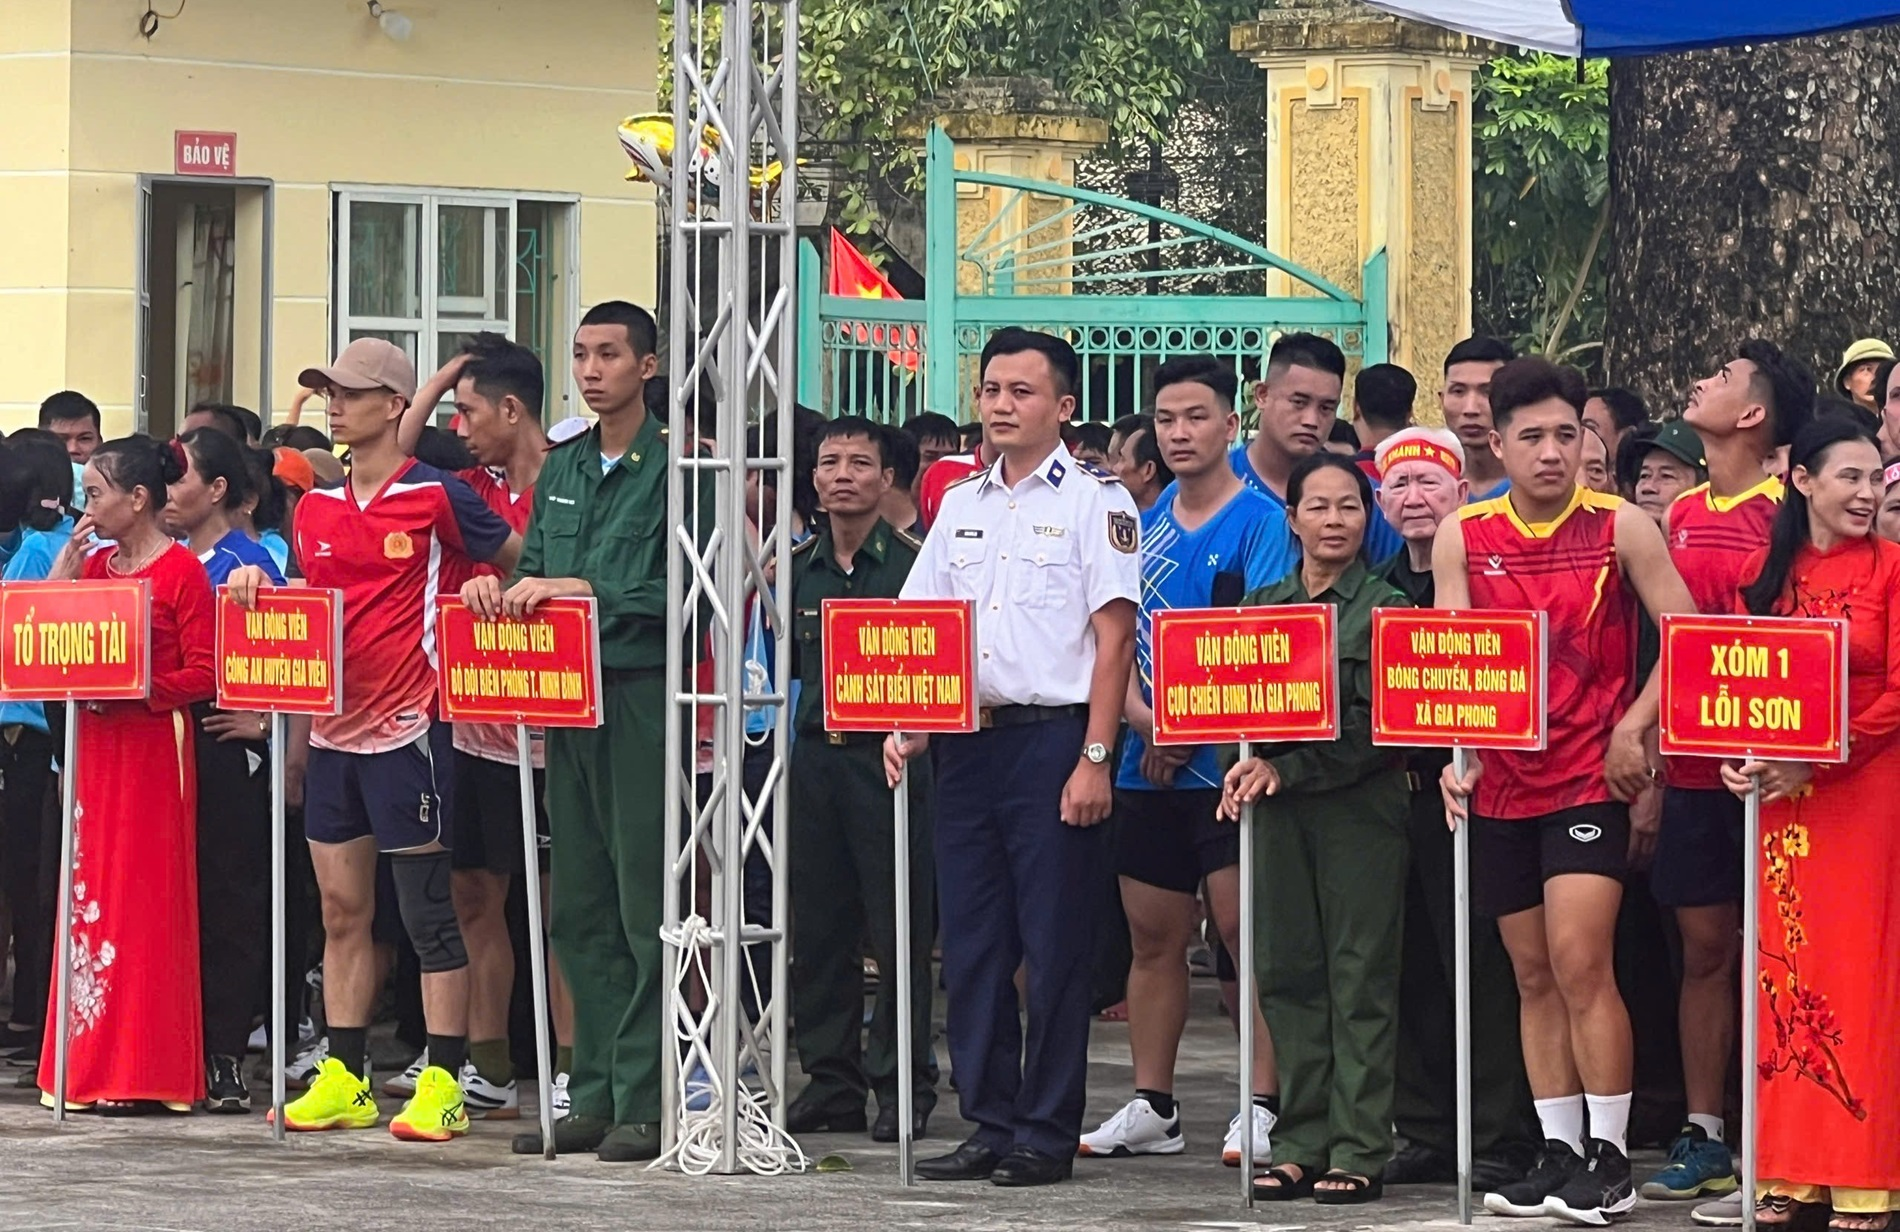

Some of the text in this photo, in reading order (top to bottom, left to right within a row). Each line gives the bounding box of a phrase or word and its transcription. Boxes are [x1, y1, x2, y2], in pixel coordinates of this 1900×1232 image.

[183, 137, 230, 170] BẢO VỆ
[13, 605, 127, 675] TỔ TRỌNG TÀI
[529, 618, 555, 653] VIÊN
[858, 620, 936, 662] VẬN ĐỘNG VIÊN
[1195, 628, 1290, 672] VẬN ĐỘNG VIÊN
[1411, 627, 1501, 659] VẬN ĐỘNG VIÊN
[225, 650, 249, 685] CÔNG
[250, 657, 263, 685] AN
[292, 658, 307, 687] GIA
[1387, 662, 1419, 689] BÓNG
[1475, 664, 1507, 692] BÓNG
[1510, 666, 1526, 693] ĐÁ
[1710, 638, 1789, 679] XÓM 1
[451, 661, 464, 702] BỘ
[479, 663, 500, 697] BIÊN
[500, 662, 529, 698] PHÒNG
[539, 671, 561, 699] NINH
[836, 661, 864, 704] CẢNH
[866, 668, 885, 704] SÁT
[912, 669, 934, 711] VIỆT
[936, 675, 961, 704] NAM
[1167, 684, 1188, 722] CỰU
[1222, 684, 1248, 714] BINH
[1250, 678, 1265, 713] XÃ
[1266, 682, 1284, 712] GIA
[1286, 681, 1321, 713] PHONG
[1416, 699, 1496, 727] XÃ GIA PHONG
[1700, 684, 1801, 730] LỖI SƠN
